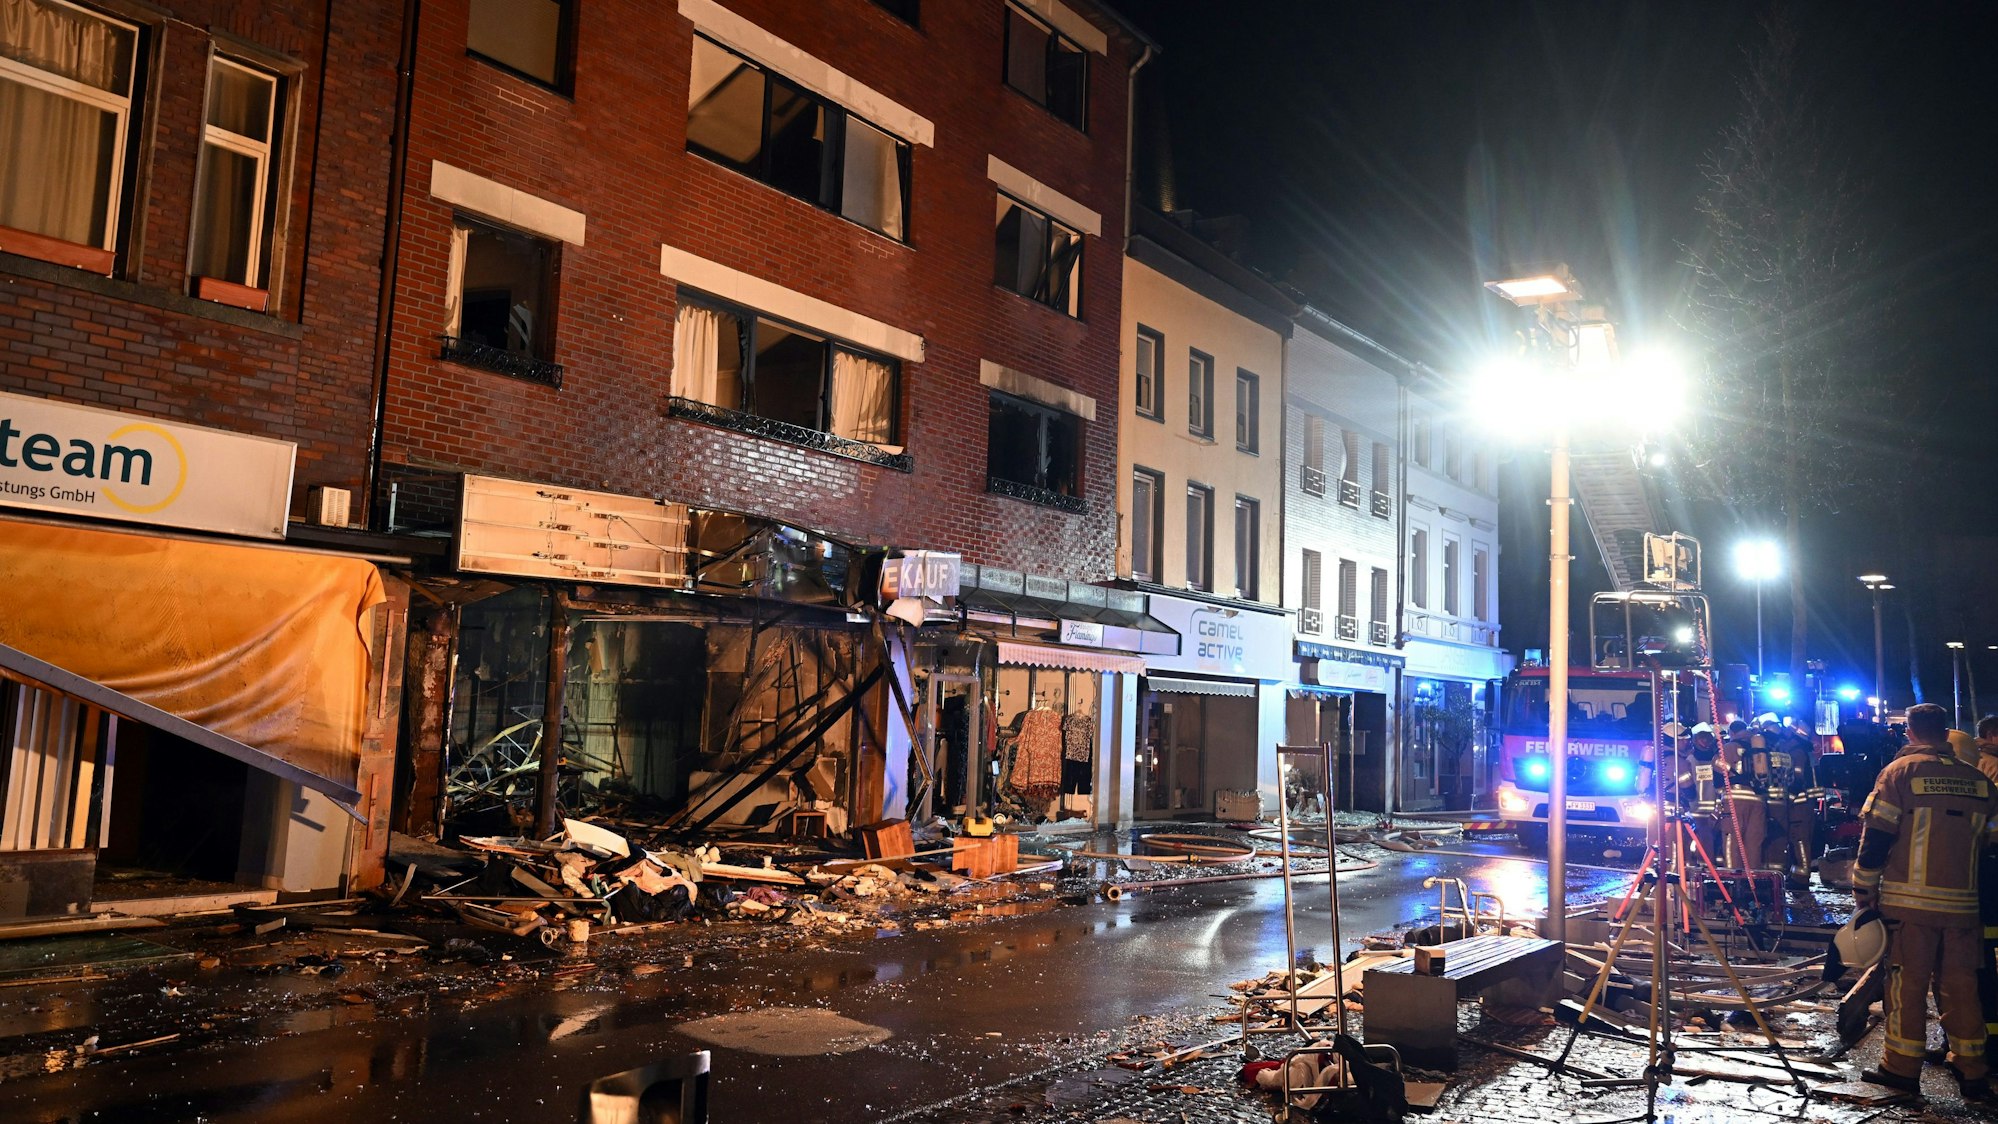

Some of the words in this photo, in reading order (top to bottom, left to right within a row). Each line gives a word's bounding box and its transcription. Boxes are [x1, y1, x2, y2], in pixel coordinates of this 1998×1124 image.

[0, 418, 152, 486] team
[50, 486, 95, 504] GmbH
[1525, 740, 1629, 757] FERWEHR
[1923, 778, 1977, 787] FEUERWEHR
[1924, 785, 1978, 795] ESCHWEILER
